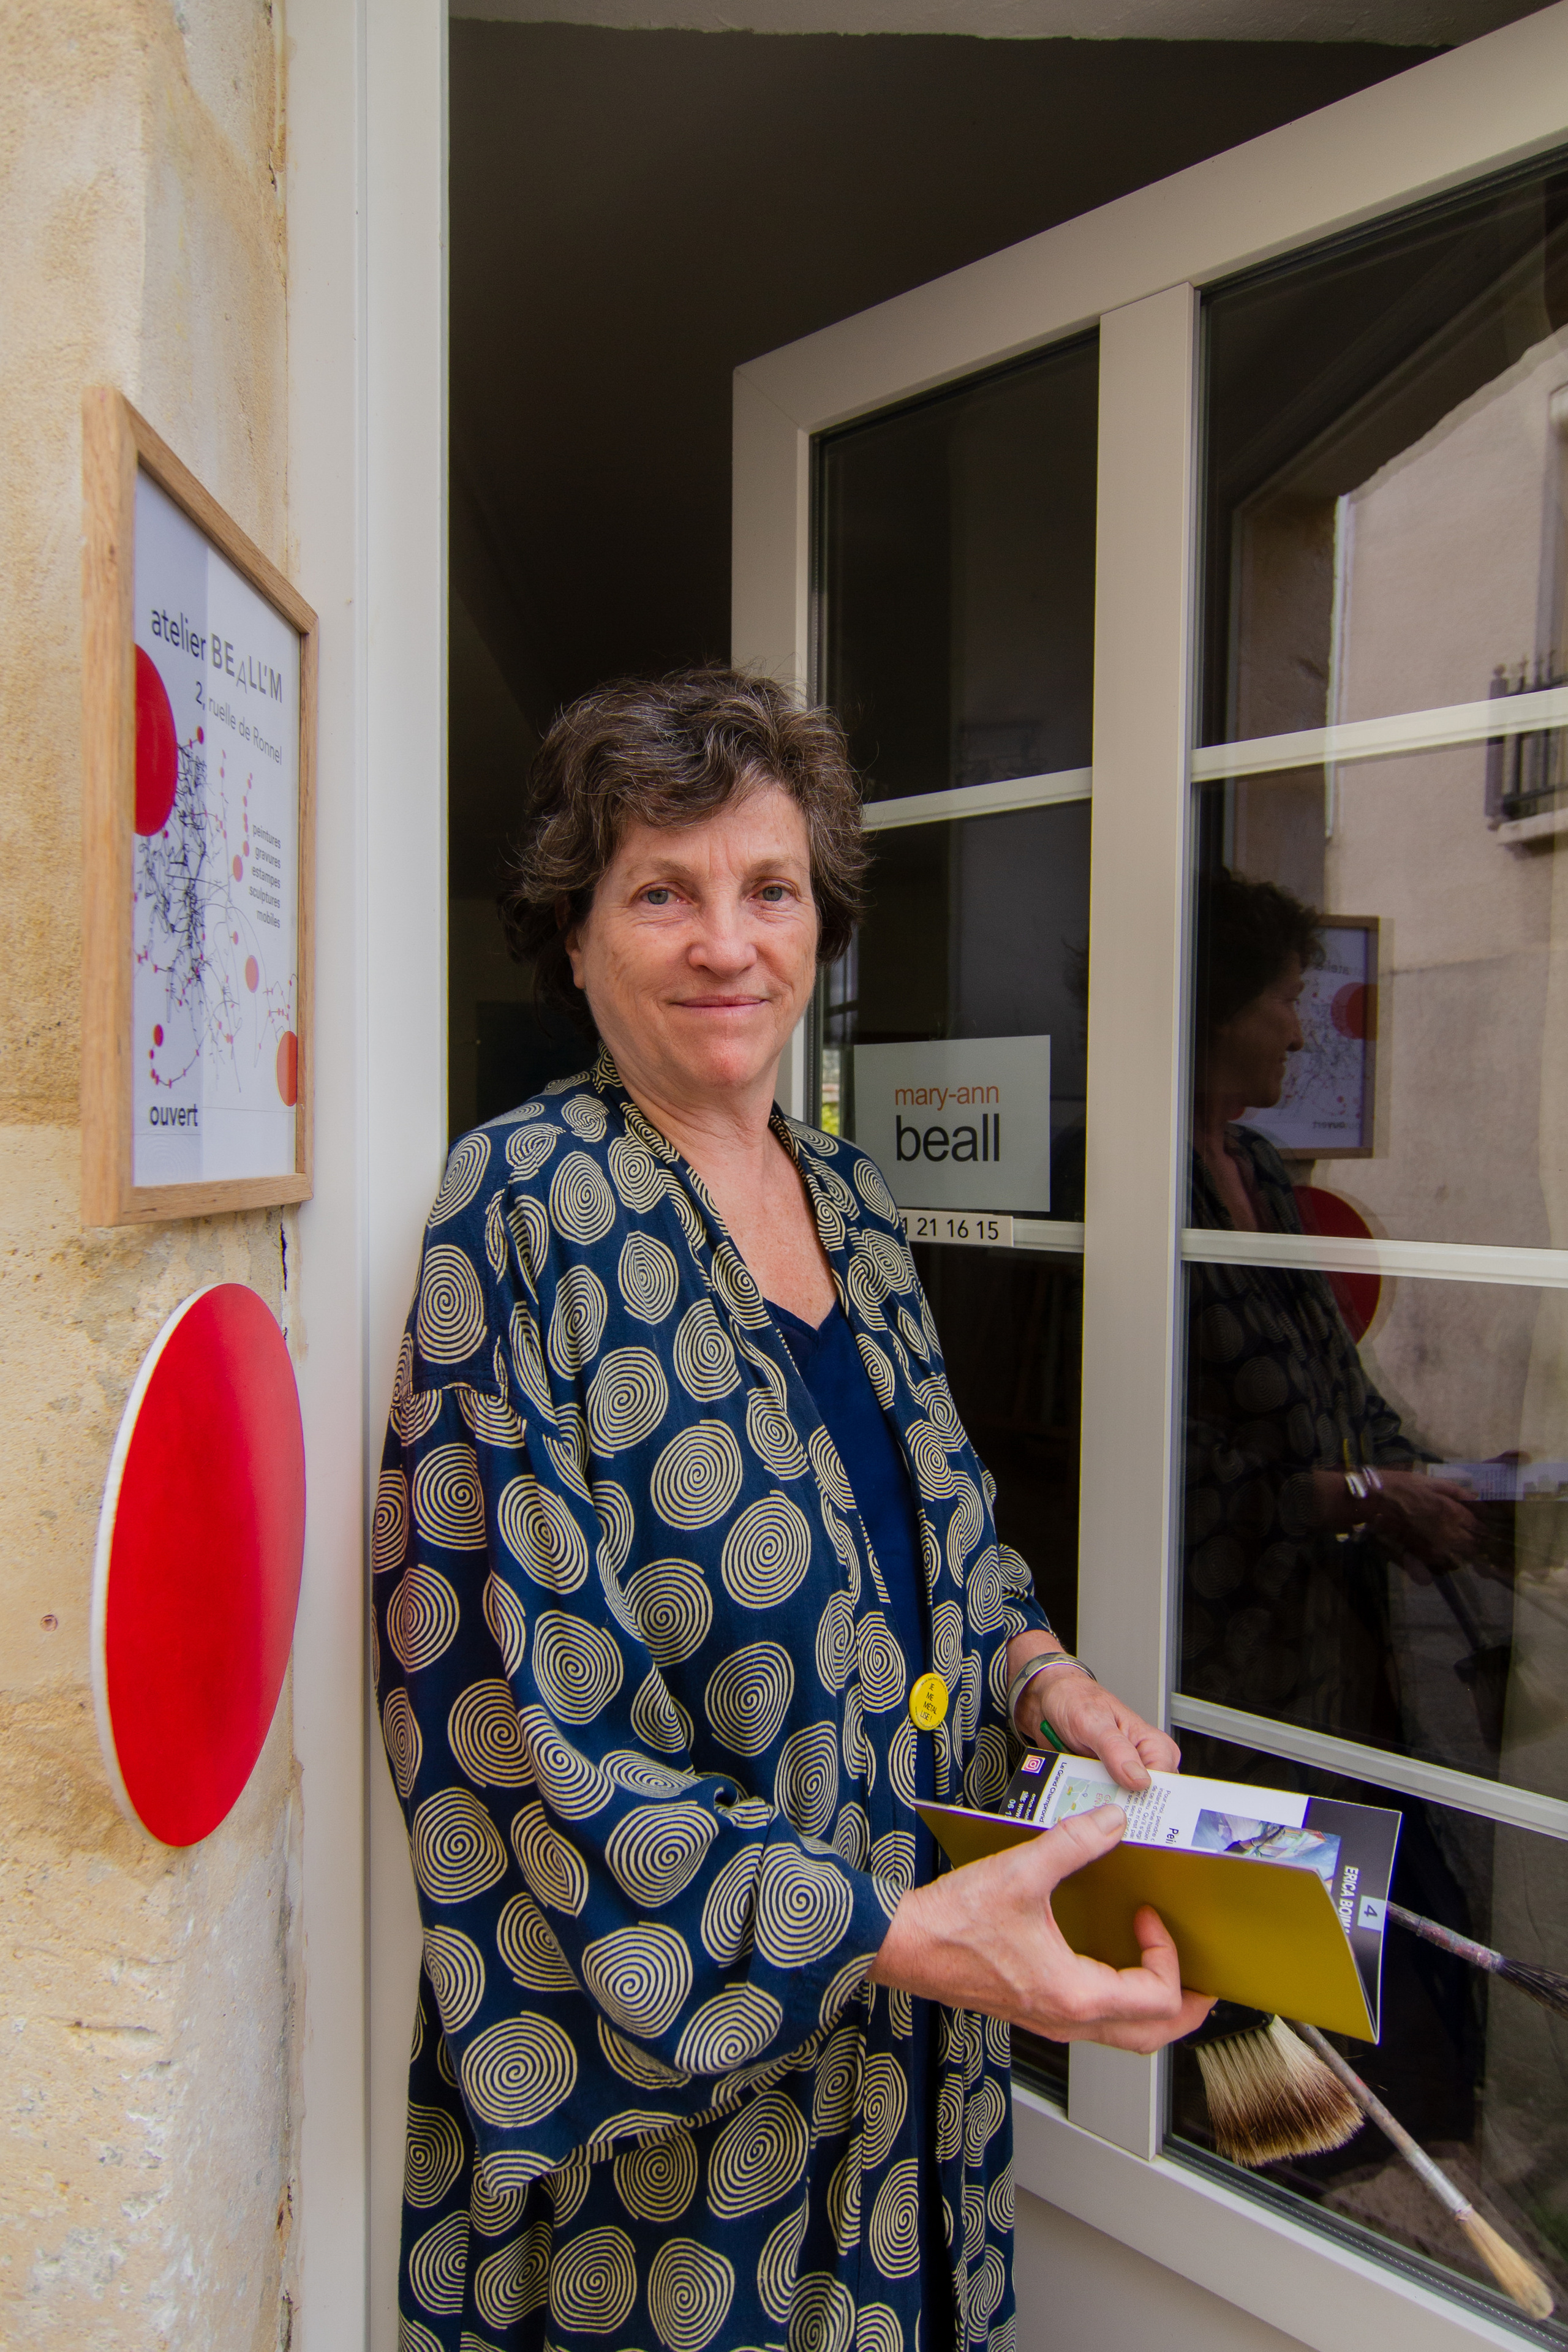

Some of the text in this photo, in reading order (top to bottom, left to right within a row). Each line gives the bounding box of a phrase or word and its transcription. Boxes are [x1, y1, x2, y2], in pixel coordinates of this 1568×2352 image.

[151, 609, 283, 704] atelier BEALL'M
[195, 680, 282, 766] 2, ruelle de Ronnel
[252, 824, 281, 849] peintures
[255, 846, 281, 869] gravures
[251, 865, 281, 889] estampes
[249, 886, 281, 909] sculptures
[256, 910, 281, 929] mobiles
[894, 1085, 1000, 1112] mary-ann
[149, 1103, 198, 1127] ouvert
[895, 1113, 1000, 1162] beall
[917, 1217, 937, 1237] 21
[947, 1219, 969, 1238] 16
[976, 1220, 999, 1240] 15
[925, 1692, 934, 1702] ME
[1052, 1770, 1064, 1789] Grand
[1007, 1798, 1016, 1809] 06
[1155, 1787, 1164, 1804] instant
[1152, 1815, 1161, 1838] peindre
[1338, 1864, 1359, 1934] ERICA BOIM
[1363, 1904, 1378, 1917] 4
